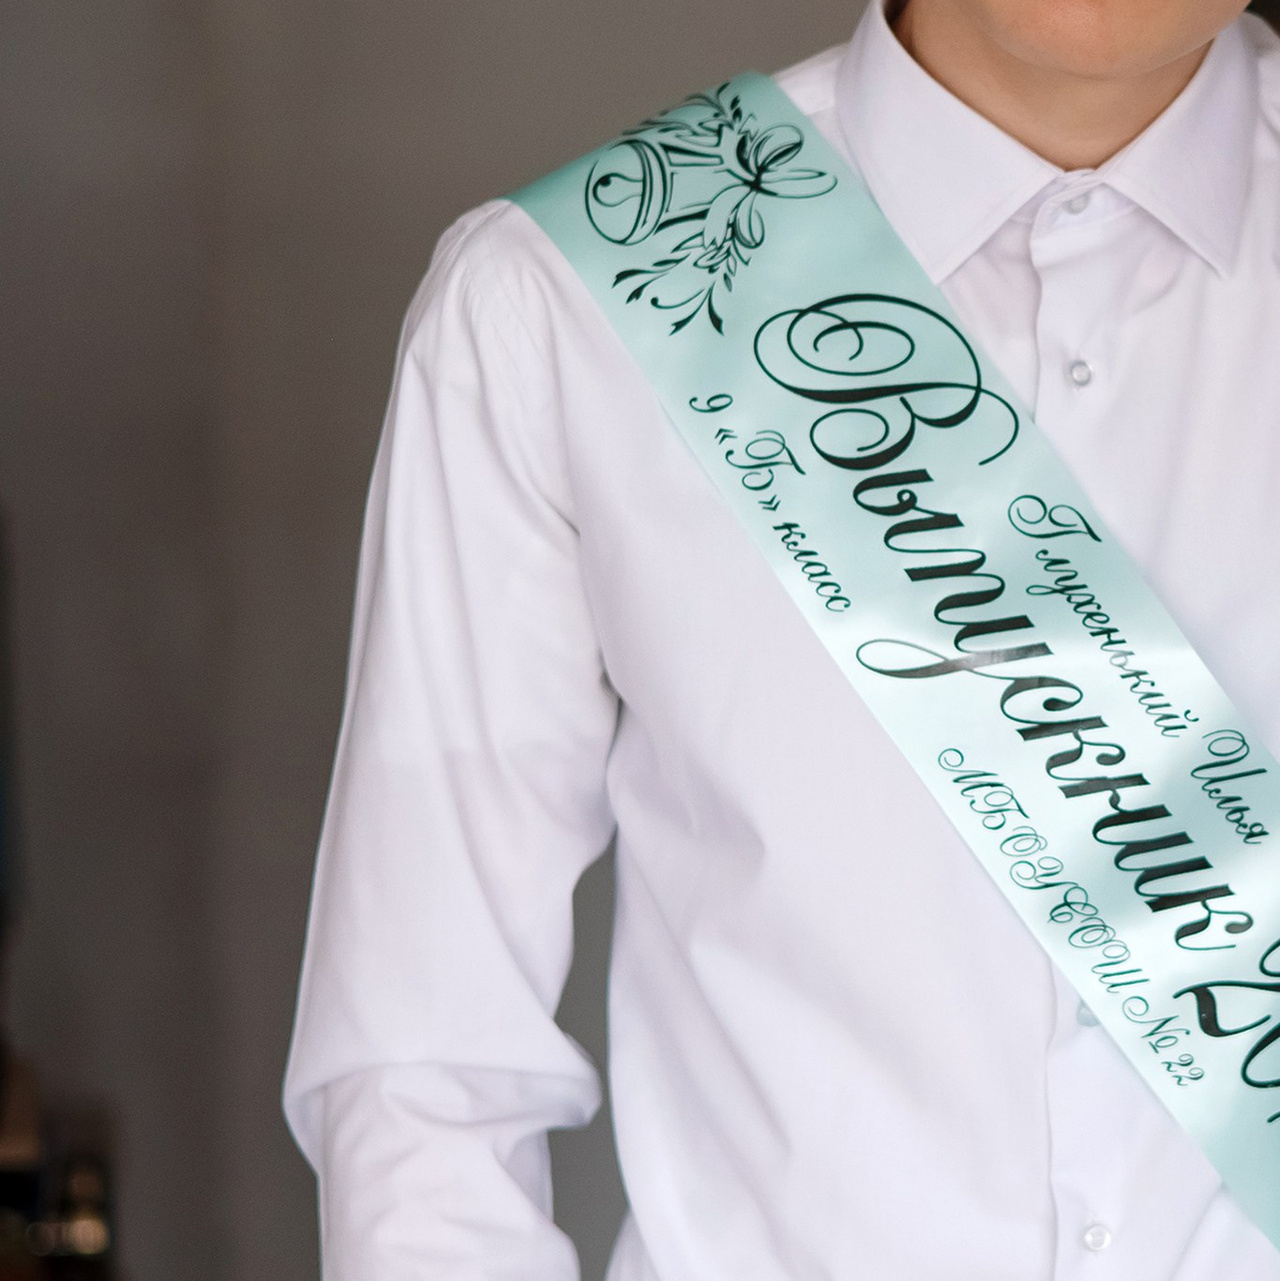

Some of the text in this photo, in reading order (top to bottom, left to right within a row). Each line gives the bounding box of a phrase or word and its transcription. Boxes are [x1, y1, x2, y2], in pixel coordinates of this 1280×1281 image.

[689, 393, 734, 414] 9
[773, 521, 851, 613] класс
[753, 293, 1254, 951] Выпускник
[1008, 495, 1270, 845] Глухенький Илья
